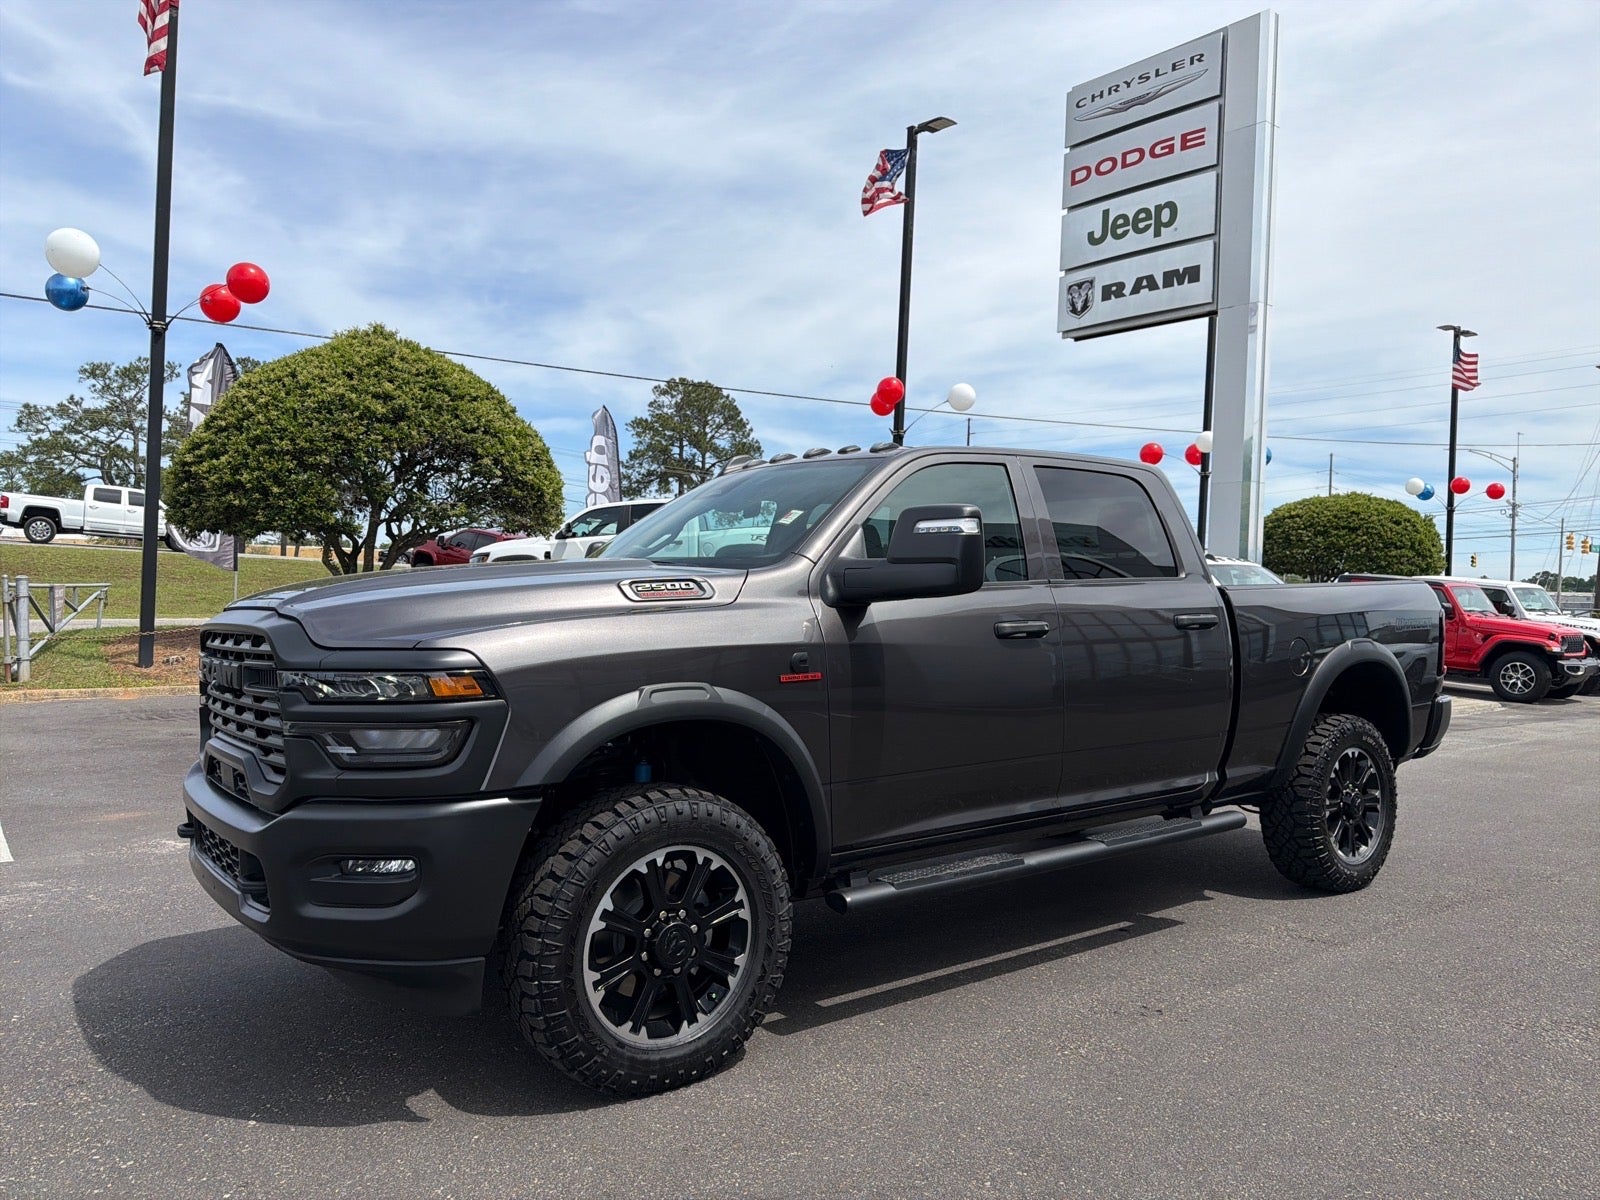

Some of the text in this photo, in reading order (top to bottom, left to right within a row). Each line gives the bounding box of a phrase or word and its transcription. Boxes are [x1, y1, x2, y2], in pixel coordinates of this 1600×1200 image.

[1075, 52, 1205, 109] CHRYSLER
[1070, 127, 1206, 187] DODGE
[1087, 200, 1178, 246] Jeep
[1101, 264, 1200, 302] RAM
[635, 581, 694, 593] 2500
